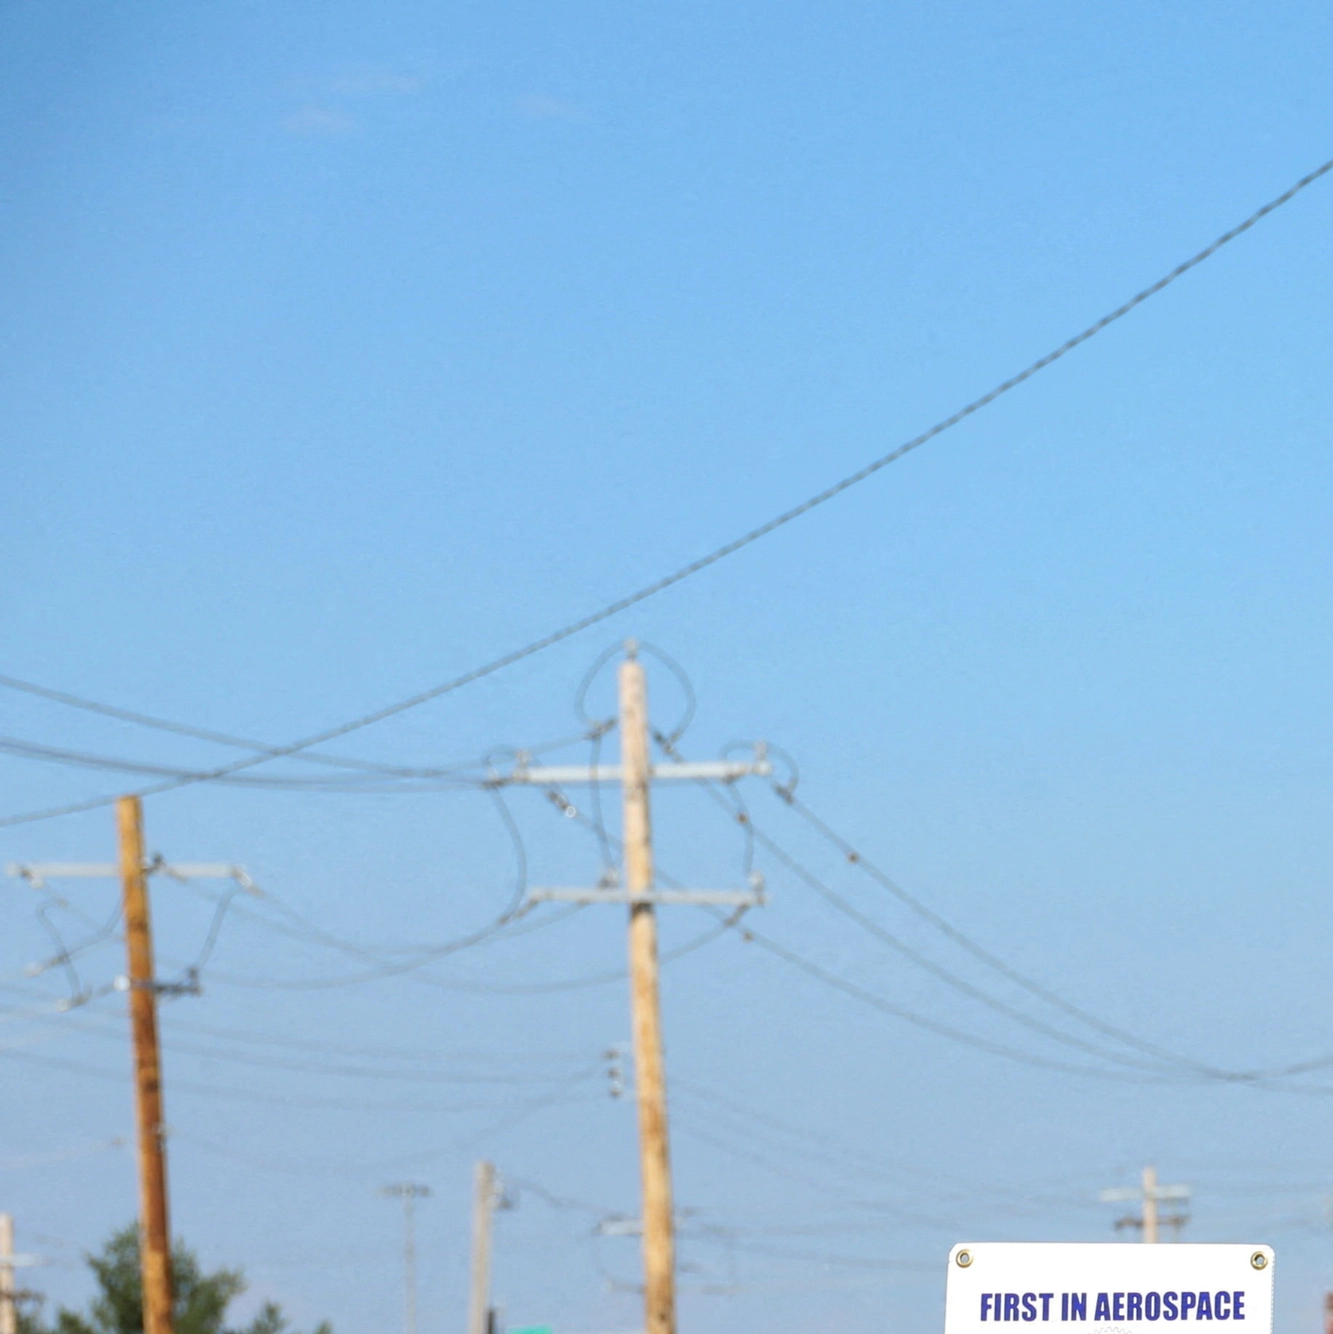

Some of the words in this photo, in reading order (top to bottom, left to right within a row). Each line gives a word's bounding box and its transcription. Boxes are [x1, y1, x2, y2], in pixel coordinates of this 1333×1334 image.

[980, 1293, 1054, 1321] FIRST
[1061, 1293, 1087, 1321] IN
[1094, 1291, 1245, 1321] AEROSPACE
